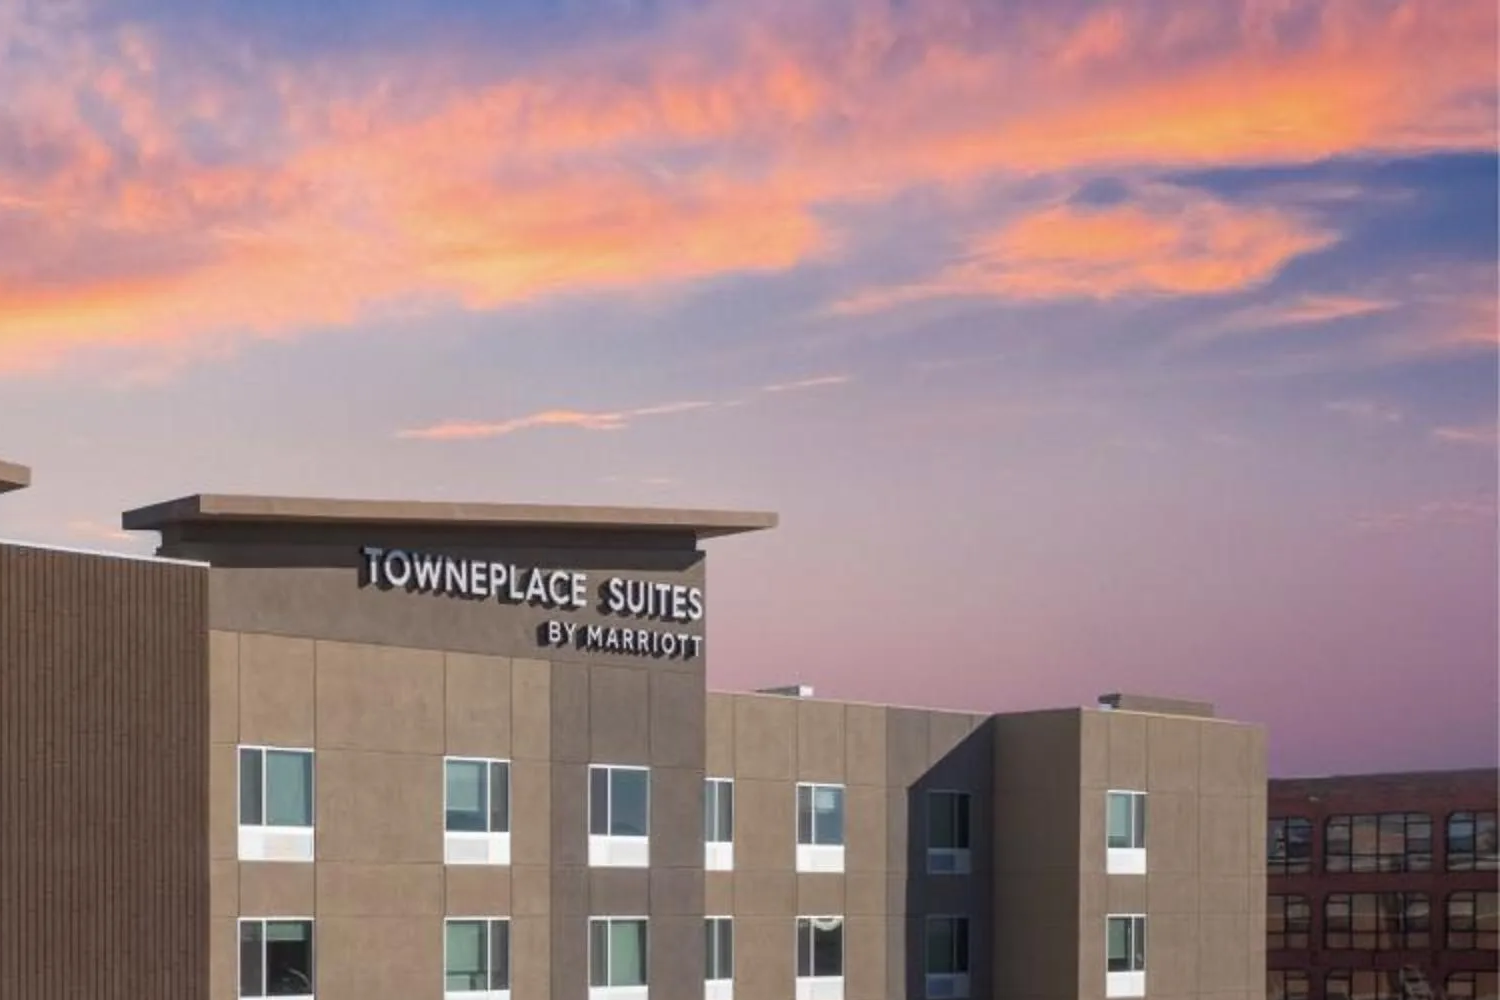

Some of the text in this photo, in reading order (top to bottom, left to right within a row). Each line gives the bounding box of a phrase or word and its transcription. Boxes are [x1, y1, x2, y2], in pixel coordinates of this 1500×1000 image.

[363, 546, 703, 620] TOWNEPLACE SUITES
[548, 620, 703, 657] BY MARRIOTT
